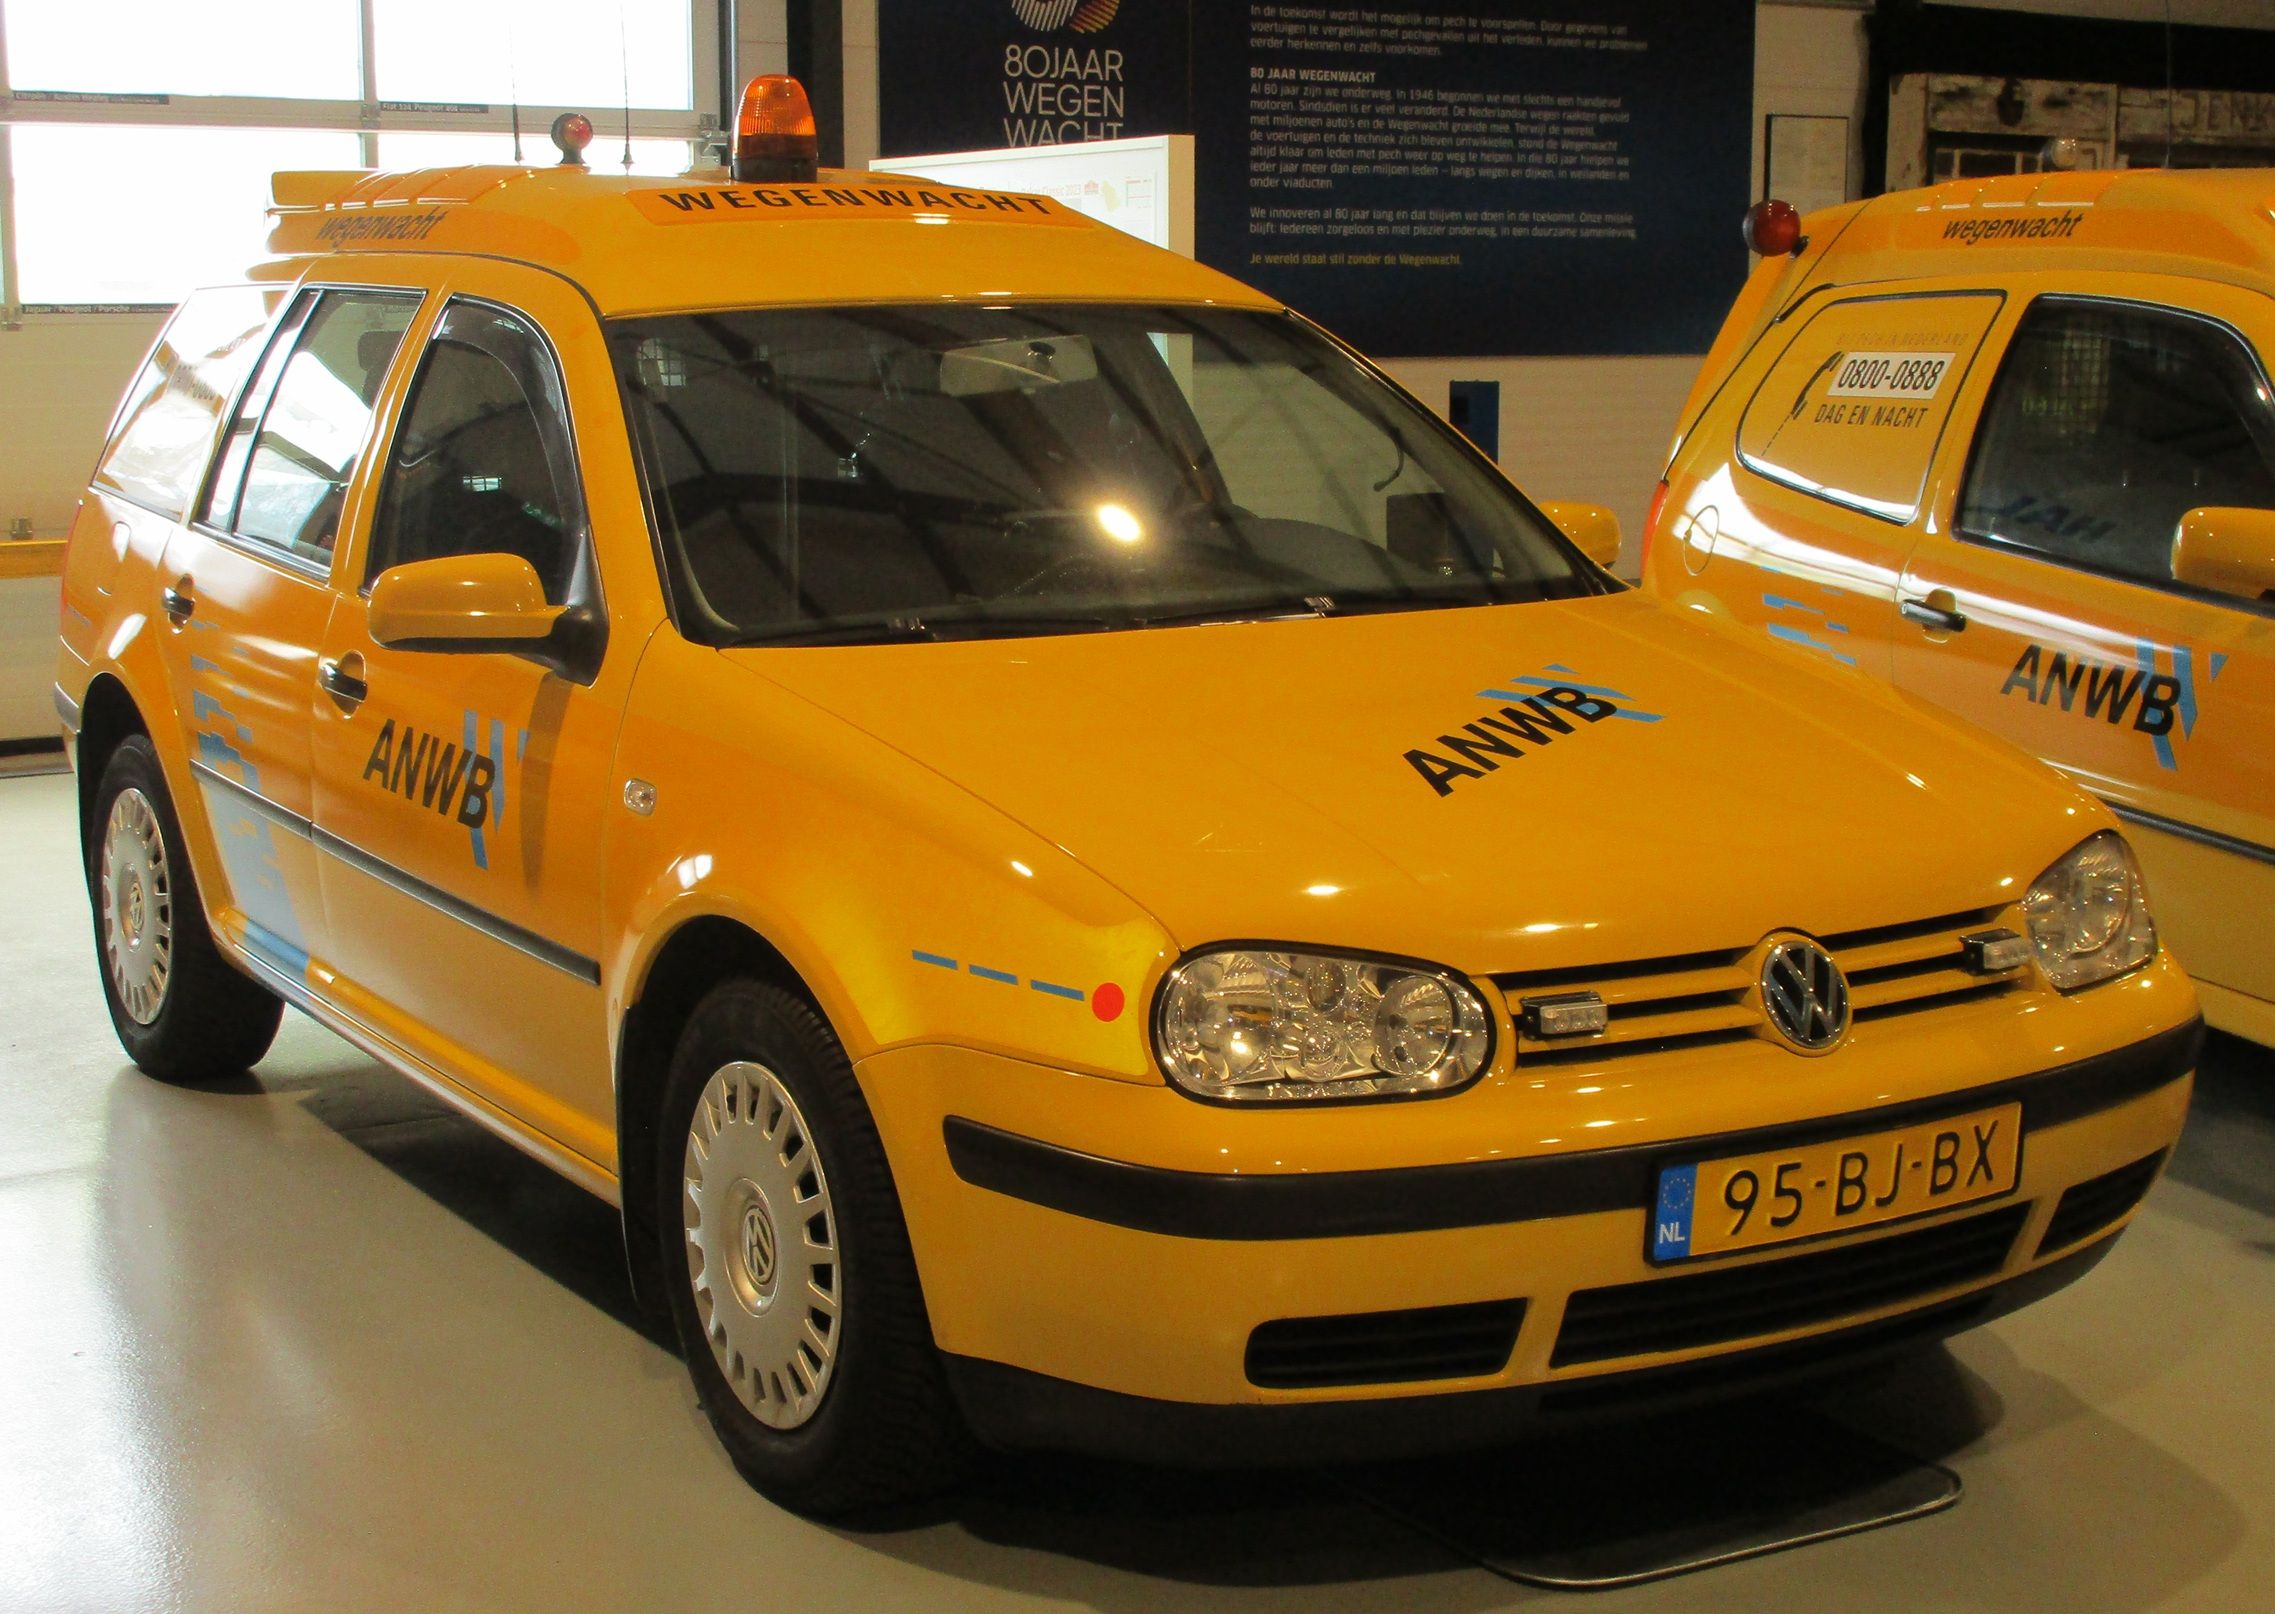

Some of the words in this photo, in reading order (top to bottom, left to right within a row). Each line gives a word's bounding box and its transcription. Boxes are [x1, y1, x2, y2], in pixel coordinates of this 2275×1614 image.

[1250, 4, 1260, 17] In
[1263, 5, 1276, 17] de
[1279, 6, 1325, 20] toekomst
[1329, 8, 1359, 22] wordt
[1361, 10, 1377, 23] het
[1250, 20, 1306, 36] voertuigen
[1309, 23, 1319, 35] te
[1321, 23, 1378, 40] vergelijken
[1379, 26, 1399, 39] met
[1250, 36, 1283, 49] eerder
[1286, 37, 1341, 52] herkennen
[1343, 42, 1356, 53] en
[1358, 41, 1382, 54] zelfs
[1003, 43, 1124, 82] 80JAAR
[1250, 67, 1264, 79] 80
[1267, 68, 1296, 80] JAAR
[1299, 69, 1376, 83] WEGENWACHT
[1002, 80, 1125, 118] WEGEN
[1250, 83, 1261, 95] Al
[1263, 83, 1278, 96] 80
[1280, 84, 1299, 98] jaar
[1303, 84, 1321, 99] zijn
[1324, 87, 1339, 98] we
[1298, 100, 1347, 113] Sindsdien
[1350, 102, 1358, 114] is
[1360, 104, 1371, 114] er
[1374, 102, 1395, 115] veel
[1250, 114, 1270, 126] met
[1272, 114, 1323, 129] miljoenen
[1325, 116, 1355, 129] auto's
[1356, 118, 1370, 129] en
[1372, 117, 1385, 130] de
[1250, 130, 1263, 142] de
[1265, 130, 1321, 145] voertuigen
[1323, 133, 1336, 144] en
[1338, 132, 1351, 144] de
[1353, 132, 1395, 146] techniek
[1250, 145, 1276, 159] altijd
[1278, 146, 1304, 158] klaar
[1306, 148, 1324, 159] om
[1326, 147, 1354, 159] leden
[1356, 147, 1375, 160] met
[1250, 161, 1276, 173] ieder
[1279, 161, 1299, 175] jaar
[1301, 164, 1327, 175] meer
[1329, 163, 1350, 175] dan
[1351, 165, 1370, 175] een
[1250, 176, 1279, 188] onder
[659, 189, 1052, 215] WEGENWACHT
[1250, 207, 1266, 219] We
[1268, 207, 1321, 220] innoveren
[1323, 208, 1333, 220] al
[1334, 208, 1348, 220] 80
[1350, 208, 1370, 222] jaar
[1372, 208, 1393, 222] lang
[315, 205, 449, 248] wegenwacht
[1326, 223, 1375, 237] zorgeloos
[1376, 225, 1390, 236] en
[1942, 209, 2085, 245] wegenwacht
[1250, 253, 1262, 265] Je
[1264, 253, 1300, 265] wereld
[1302, 253, 1327, 265] staat
[1329, 253, 1345, 265] stil
[1346, 253, 1382, 265] zonder
[1384, 253, 1397, 265] de
[1838, 358, 1946, 391] 0800-0888
[1814, 403, 1847, 424] DAG
[1848, 405, 1871, 426] EN
[1872, 406, 1929, 429] NACHT
[2001, 643, 2182, 736] ANWB
[1402, 686, 1618, 798] ANWB
[363, 718, 496, 830] ANWB
[1723, 1120, 1999, 1236] 95-BJ-BX
[1658, 1221, 1686, 1244] NL
